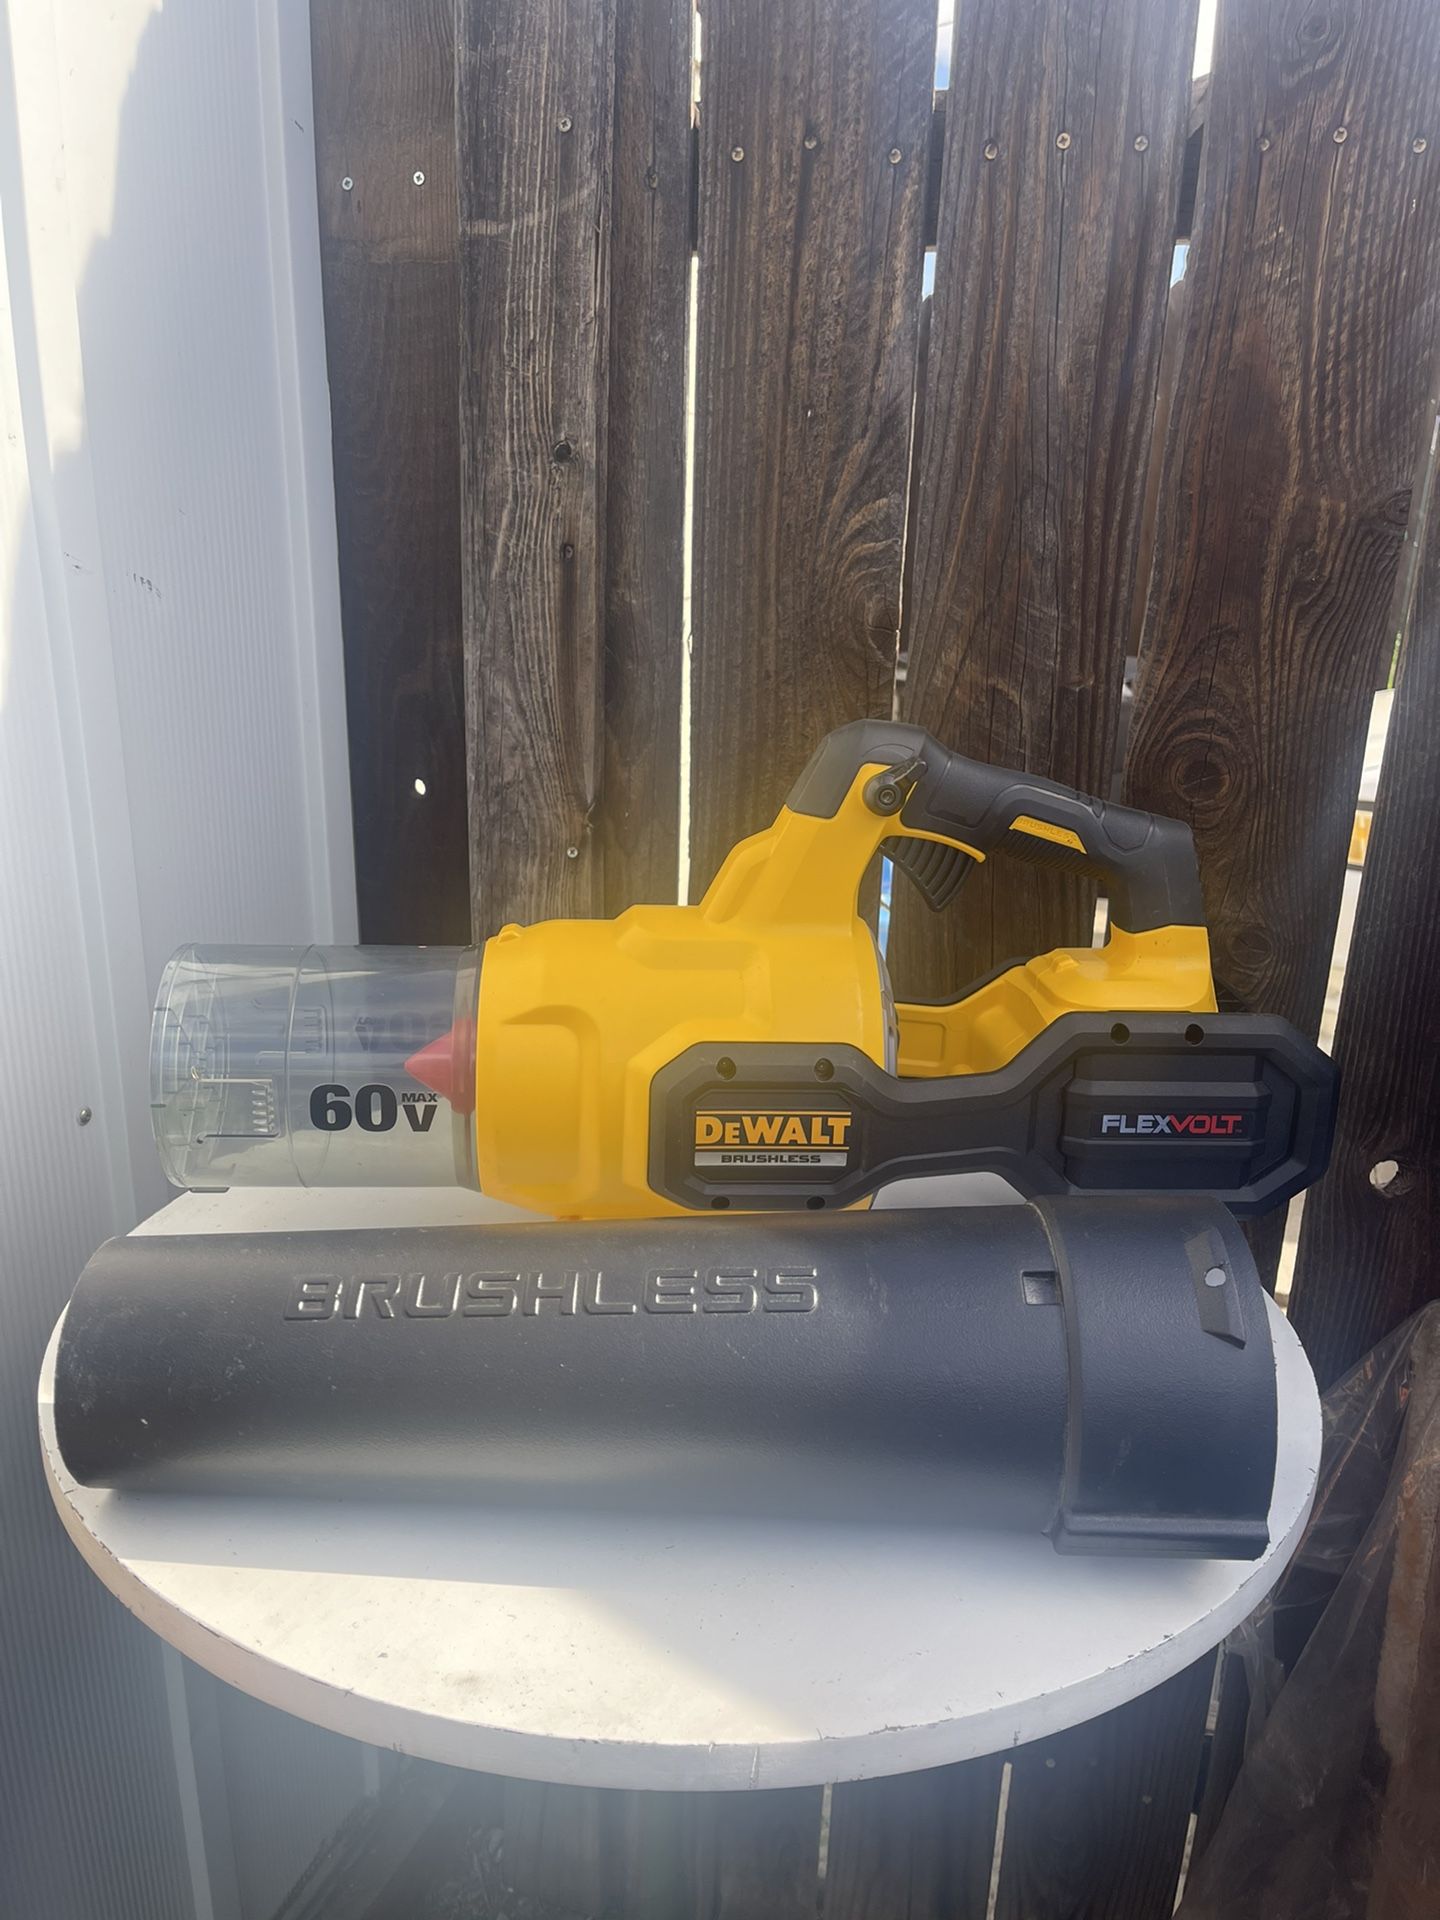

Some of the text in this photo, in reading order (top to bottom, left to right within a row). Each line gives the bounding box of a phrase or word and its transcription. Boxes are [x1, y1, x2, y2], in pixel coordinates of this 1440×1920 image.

[401, 1092, 438, 1103] MAX
[1101, 1114, 1242, 1134] FLEXVOLT
[720, 1153, 821, 1164] BRUSHLESS
[283, 1266, 819, 1322] BRUSHLESS
